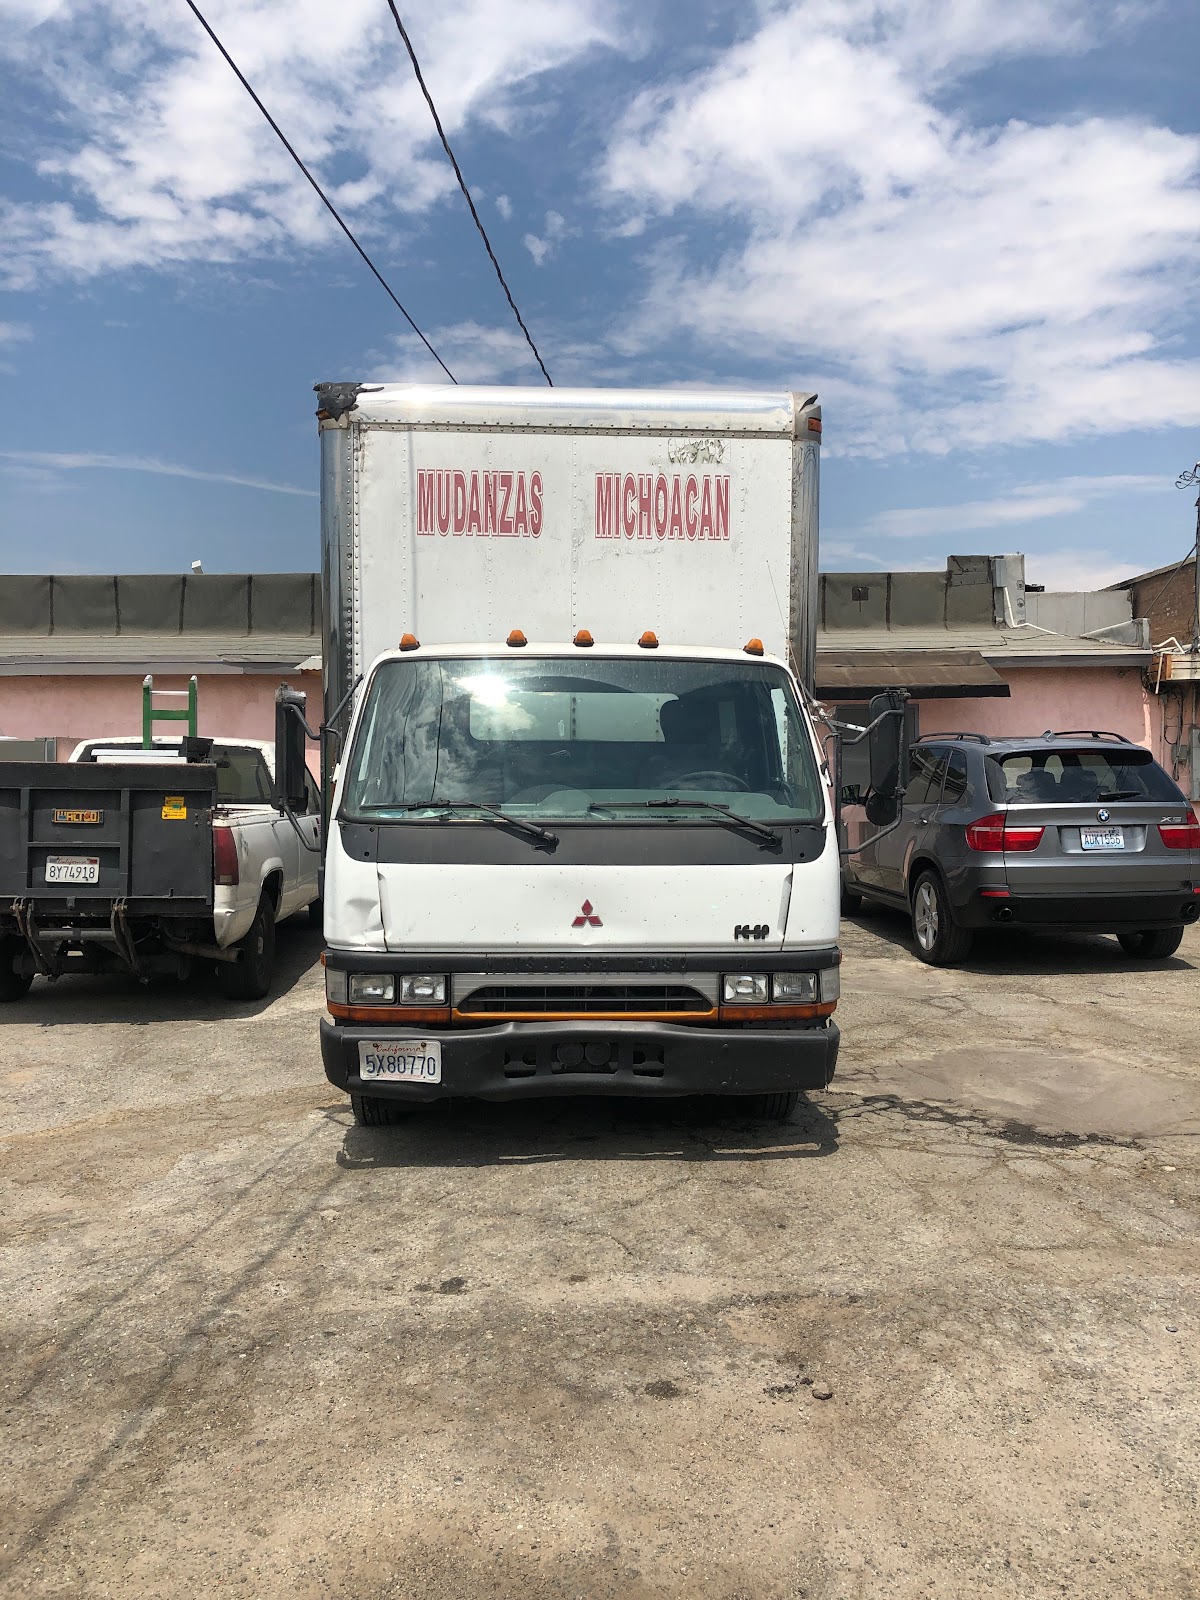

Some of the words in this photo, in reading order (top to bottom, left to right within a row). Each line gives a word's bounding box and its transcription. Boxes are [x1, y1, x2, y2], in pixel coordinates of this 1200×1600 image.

[417, 468, 544, 538] MUDANZAS
[595, 472, 731, 541] MICHOACAN
[1085, 834, 1121, 845] AUK1556
[49, 865, 95, 879] 8Y74918
[375, 1043, 421, 1054] California
[365, 1054, 436, 1076] 5X80770
